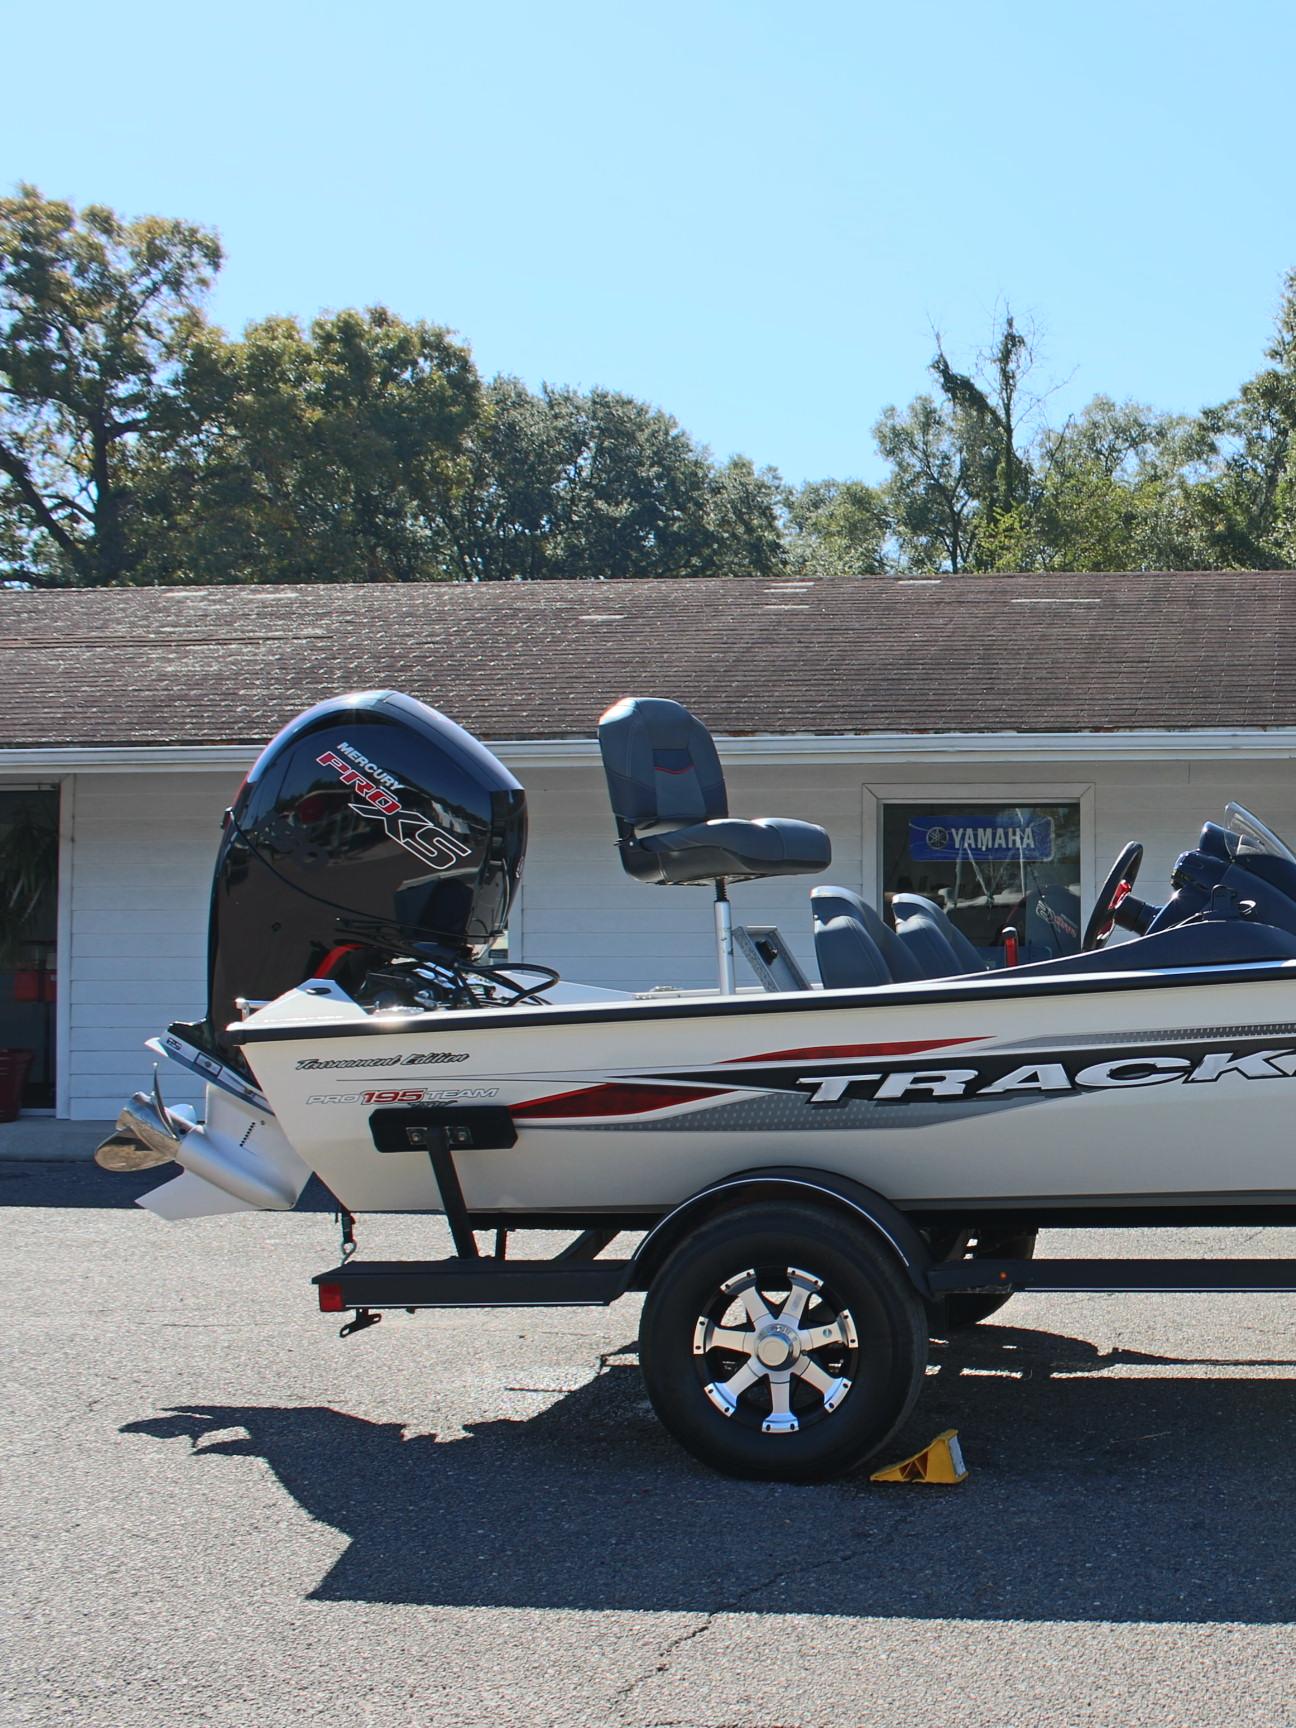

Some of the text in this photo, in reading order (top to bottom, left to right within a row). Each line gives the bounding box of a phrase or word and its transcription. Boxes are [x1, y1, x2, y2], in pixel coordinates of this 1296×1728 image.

[337, 742, 405, 790] MERCURY
[316, 751, 472, 870] PRO XS
[951, 827, 1036, 850] YAMAHA
[295, 1052, 470, 1070] Tournament Edition
[306, 1093, 361, 1105] PRO
[361, 1087, 428, 1106] 195
[426, 1087, 499, 1100] TEAM
